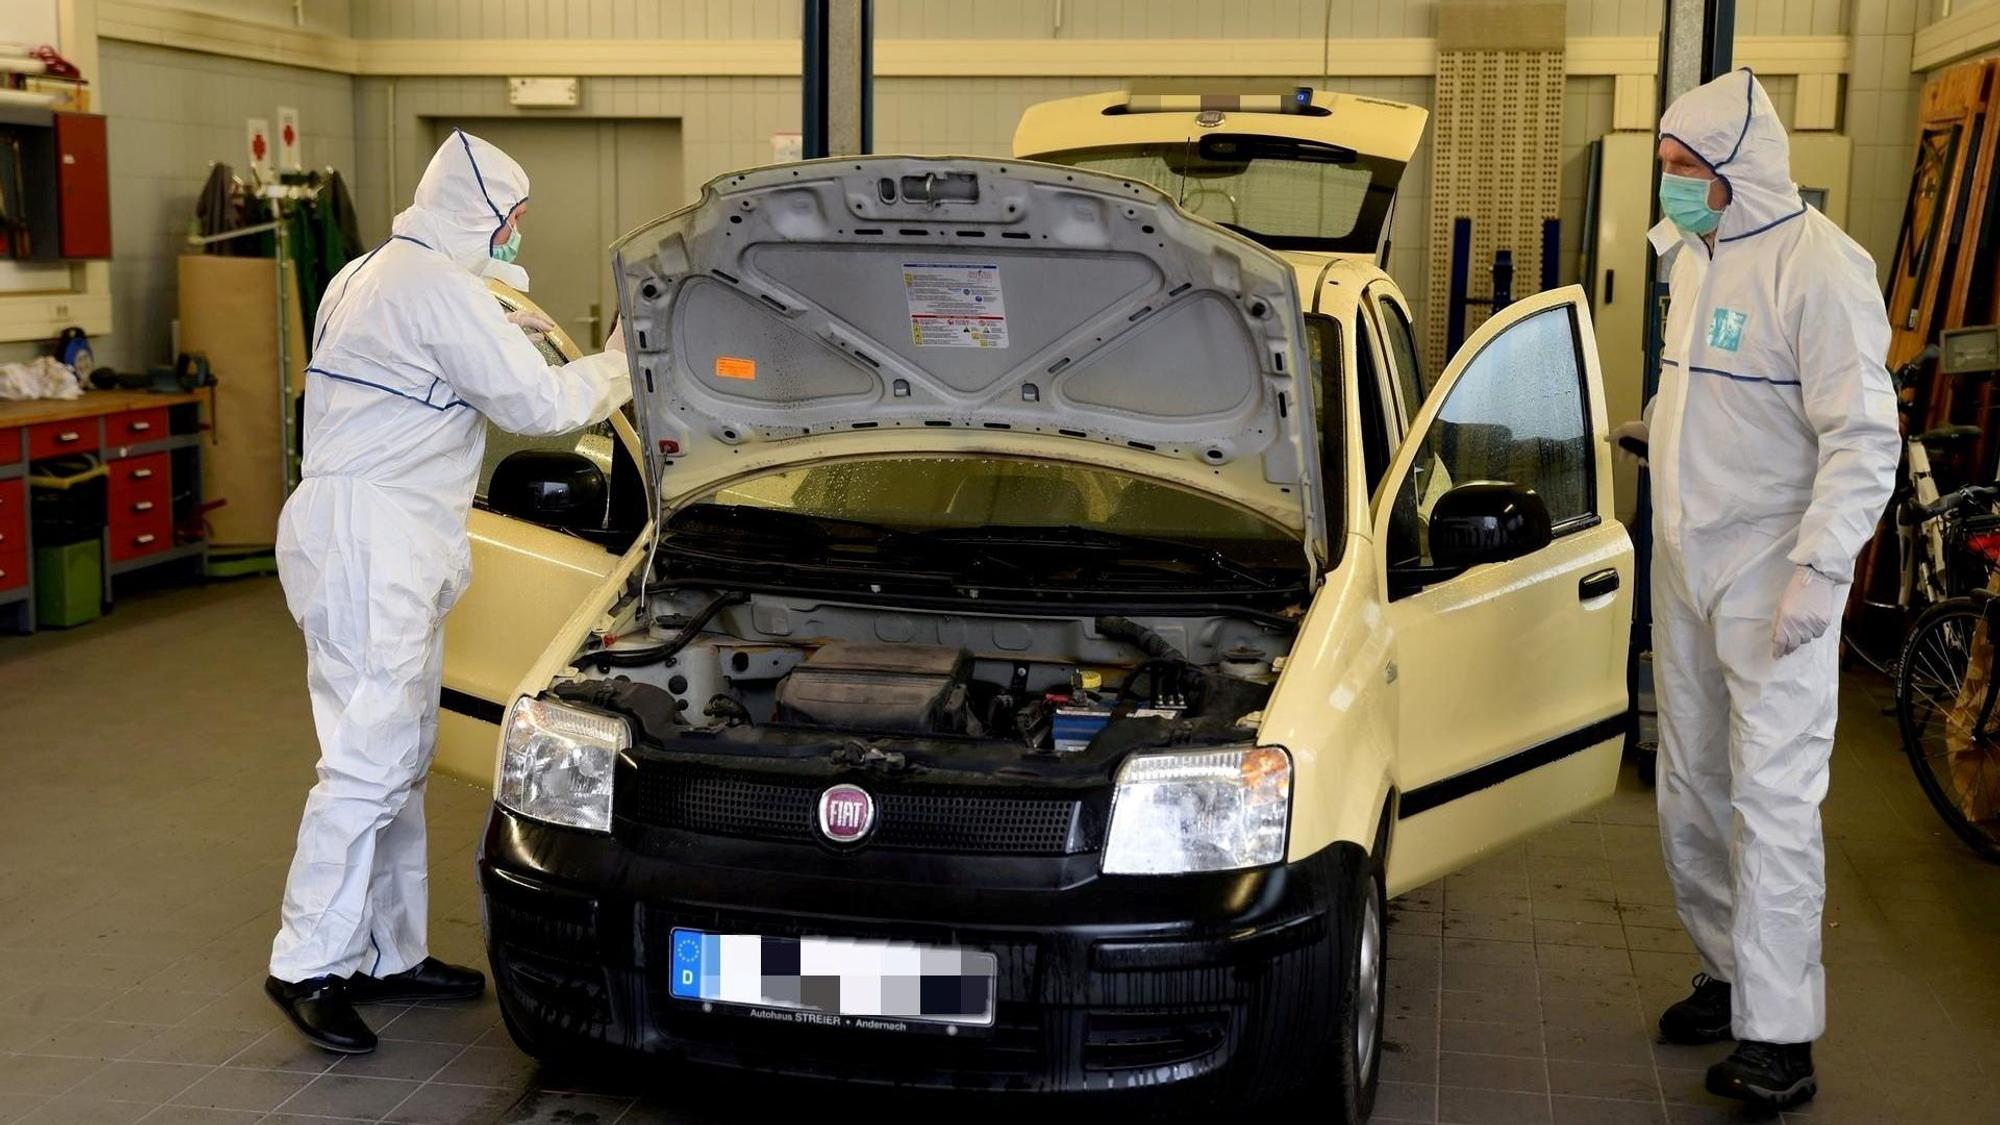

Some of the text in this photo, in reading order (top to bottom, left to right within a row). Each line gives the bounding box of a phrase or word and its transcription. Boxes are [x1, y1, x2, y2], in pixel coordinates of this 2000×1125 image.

[830, 800, 863, 827] FIAT
[682, 969, 693, 984] D
[750, 1008, 907, 1032] Autohaus STREIER Andernach
